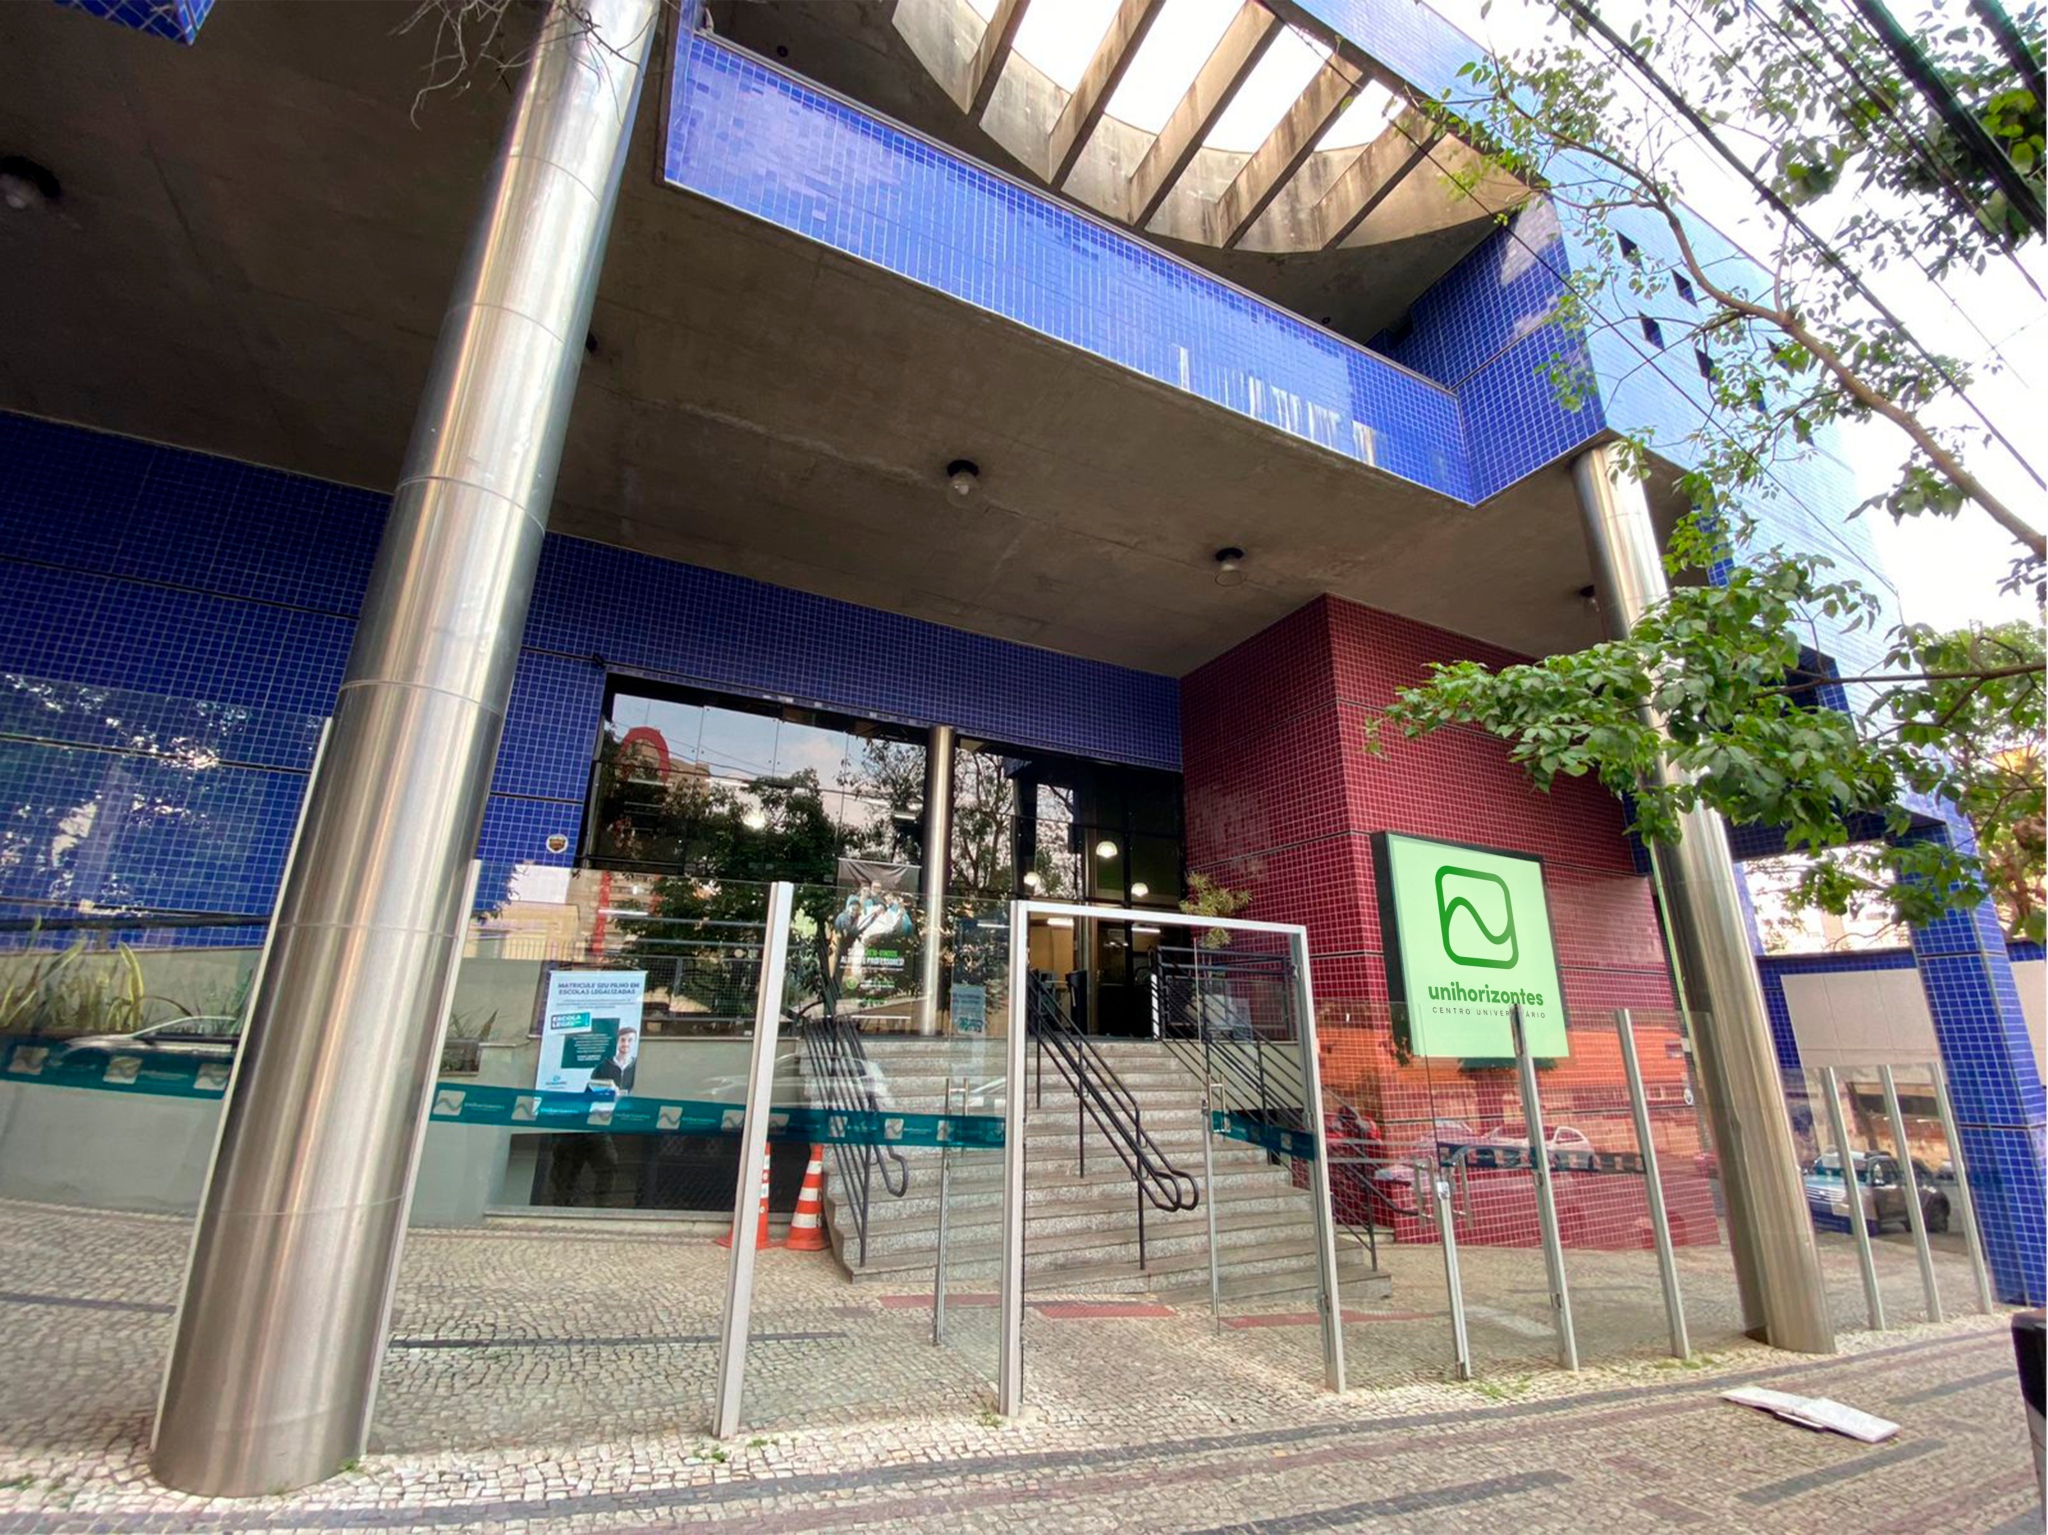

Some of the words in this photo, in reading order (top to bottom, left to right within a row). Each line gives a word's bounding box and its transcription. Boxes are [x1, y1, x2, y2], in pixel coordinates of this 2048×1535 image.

[1428, 981, 1544, 1006] unihorizontes
[1432, 1006, 1471, 1015] CENTRO
[1476, 1009, 1546, 1019] UNIVERÁRIO
